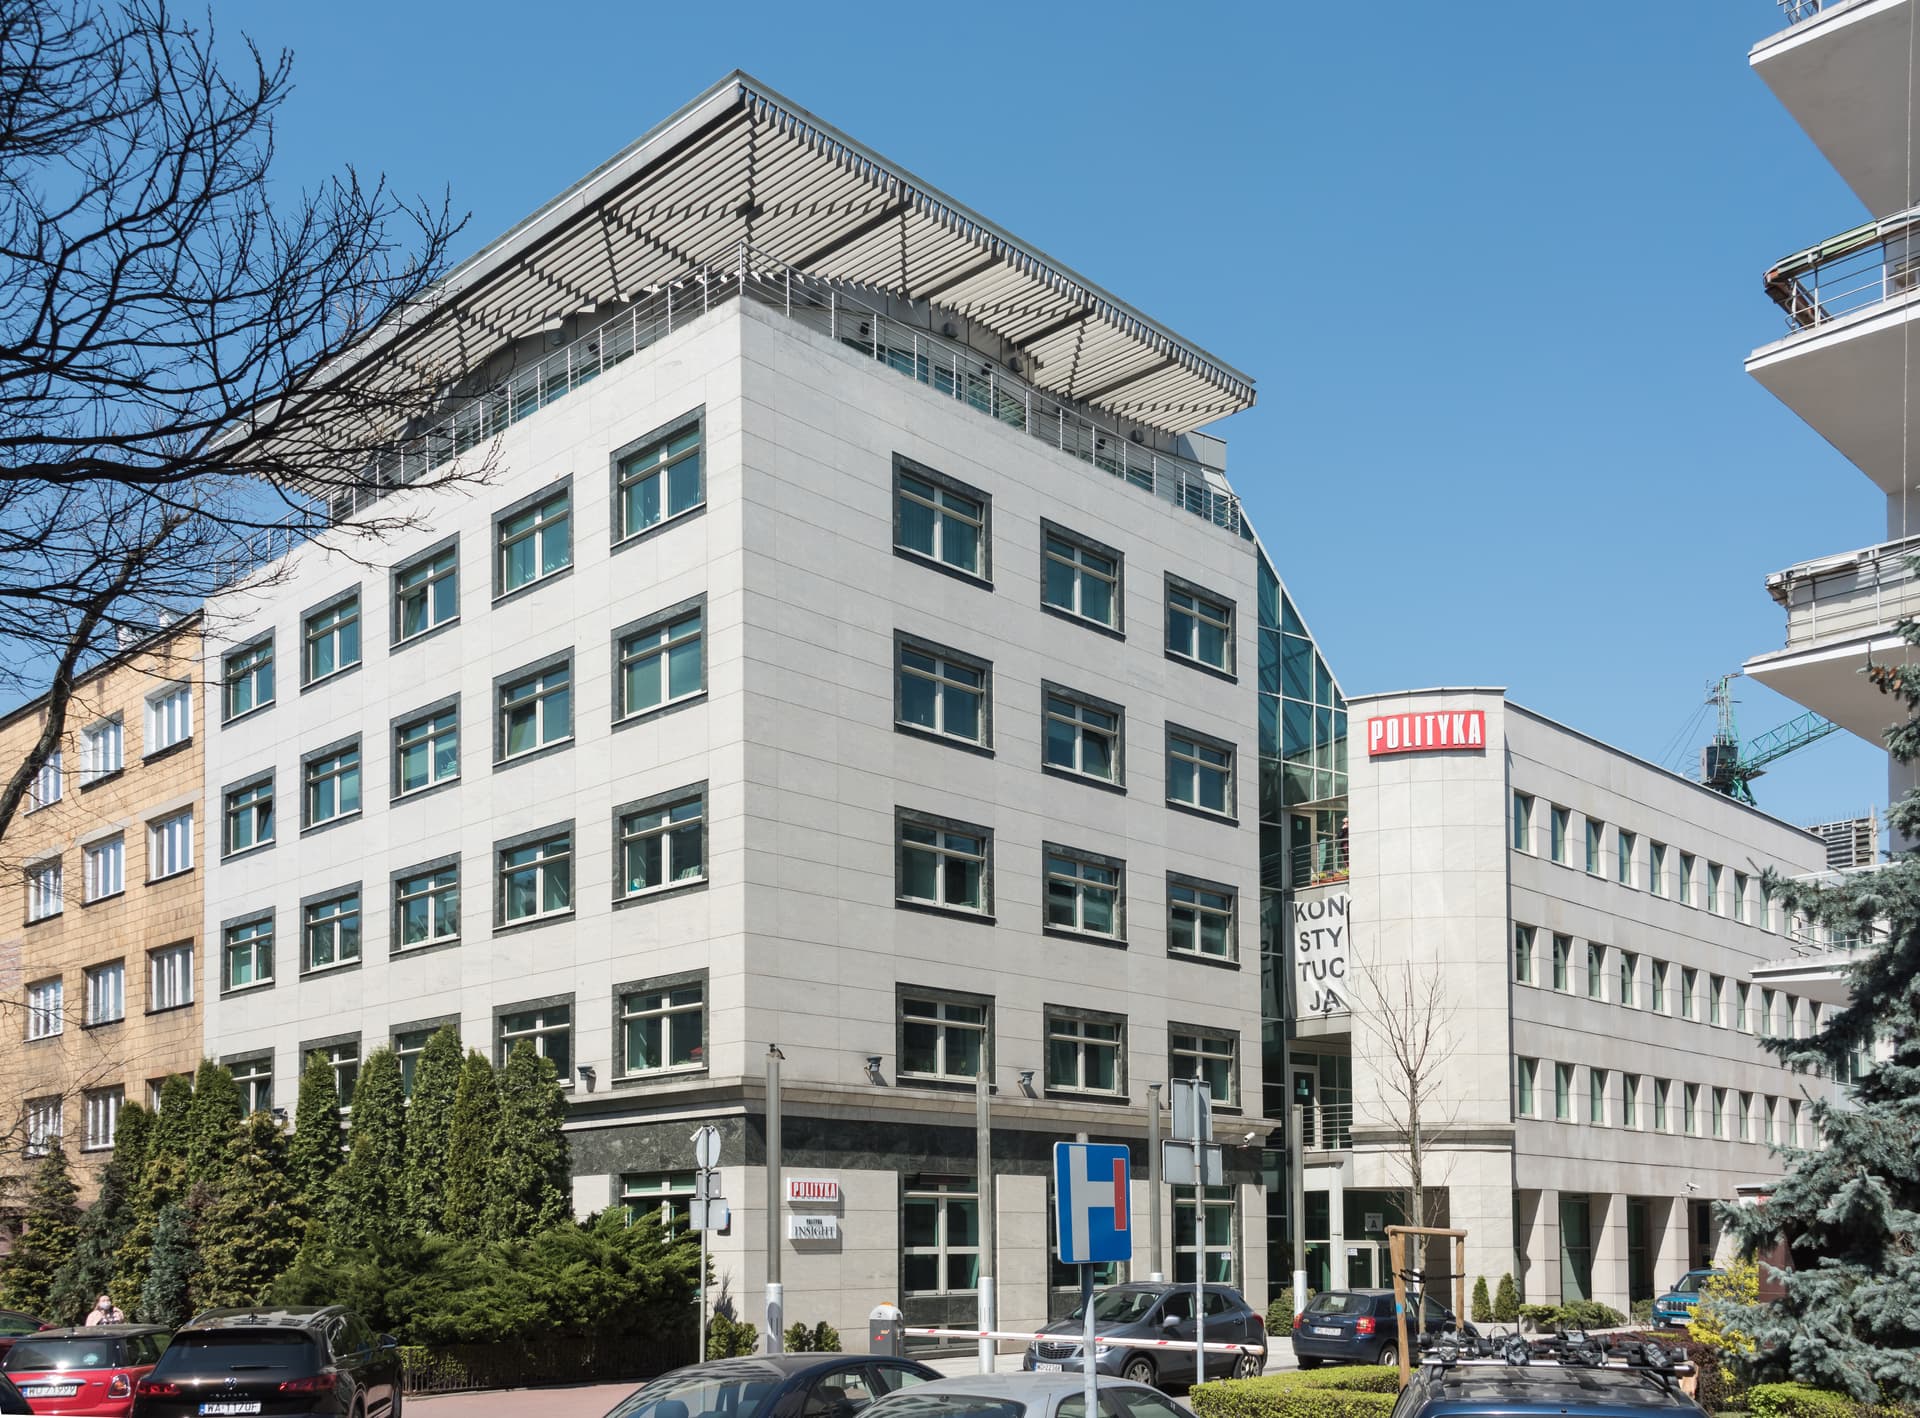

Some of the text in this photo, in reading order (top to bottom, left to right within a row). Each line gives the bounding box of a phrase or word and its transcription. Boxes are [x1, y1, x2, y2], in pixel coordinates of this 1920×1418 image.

[1371, 713, 1482, 751] POLITYKA
[1294, 895, 1345, 923] KON
[1300, 926, 1343, 952] STY
[1298, 957, 1345, 982] TUC
[1309, 988, 1341, 1012] JA
[793, 1182, 837, 1197] POLITYKA
[794, 1226, 834, 1237] INSIGHT
